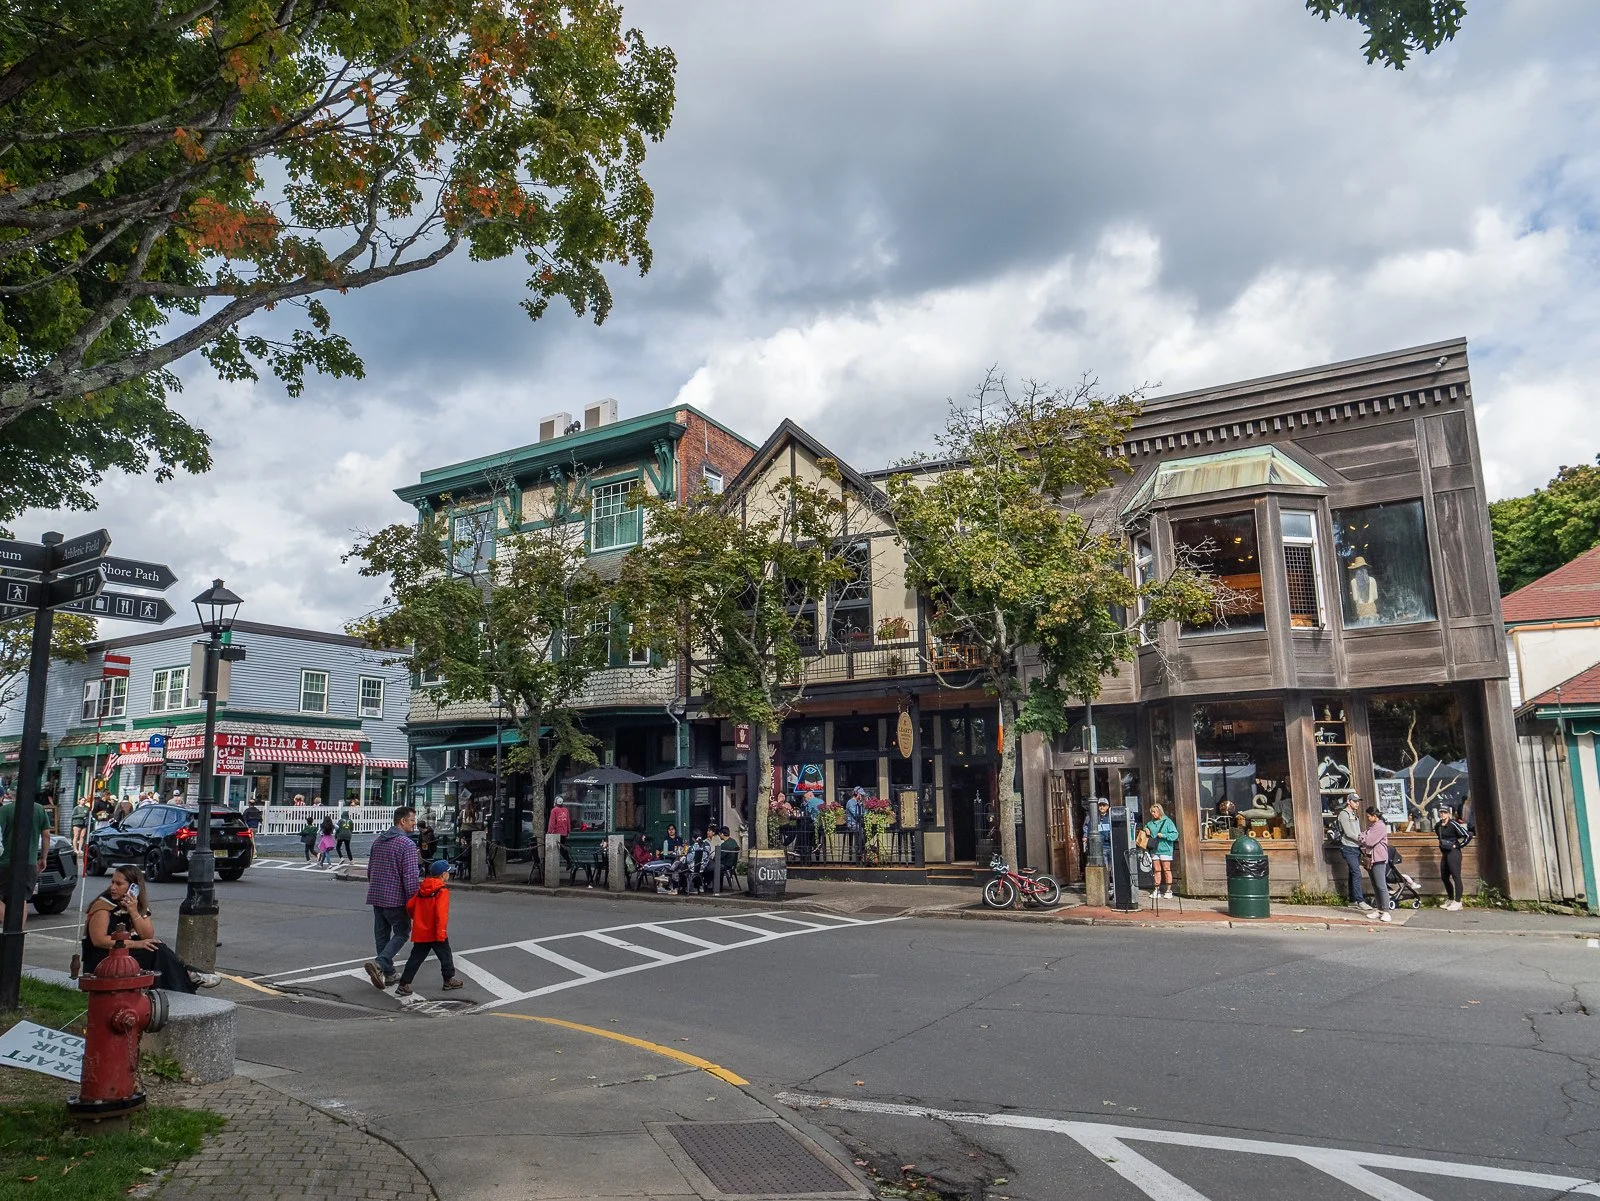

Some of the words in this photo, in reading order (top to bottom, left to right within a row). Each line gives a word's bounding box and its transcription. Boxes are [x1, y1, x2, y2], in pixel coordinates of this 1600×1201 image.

[0, 551, 21, 561] um
[63, 546, 84, 560] Athletic
[85, 539, 100, 554] Field
[100, 562, 132, 577] Shore
[135, 567, 160, 582] Path
[167, 736, 196, 750] DIPPER
[226, 735, 247, 746] ICE
[254, 736, 297, 749] CREAM
[301, 739, 309, 749] &
[313, 740, 354, 752] YOGURT
[28, 1028, 85, 1049] DAY
[32, 1040, 84, 1062] FAIR
[2, 1050, 82, 1077] CRAFT
